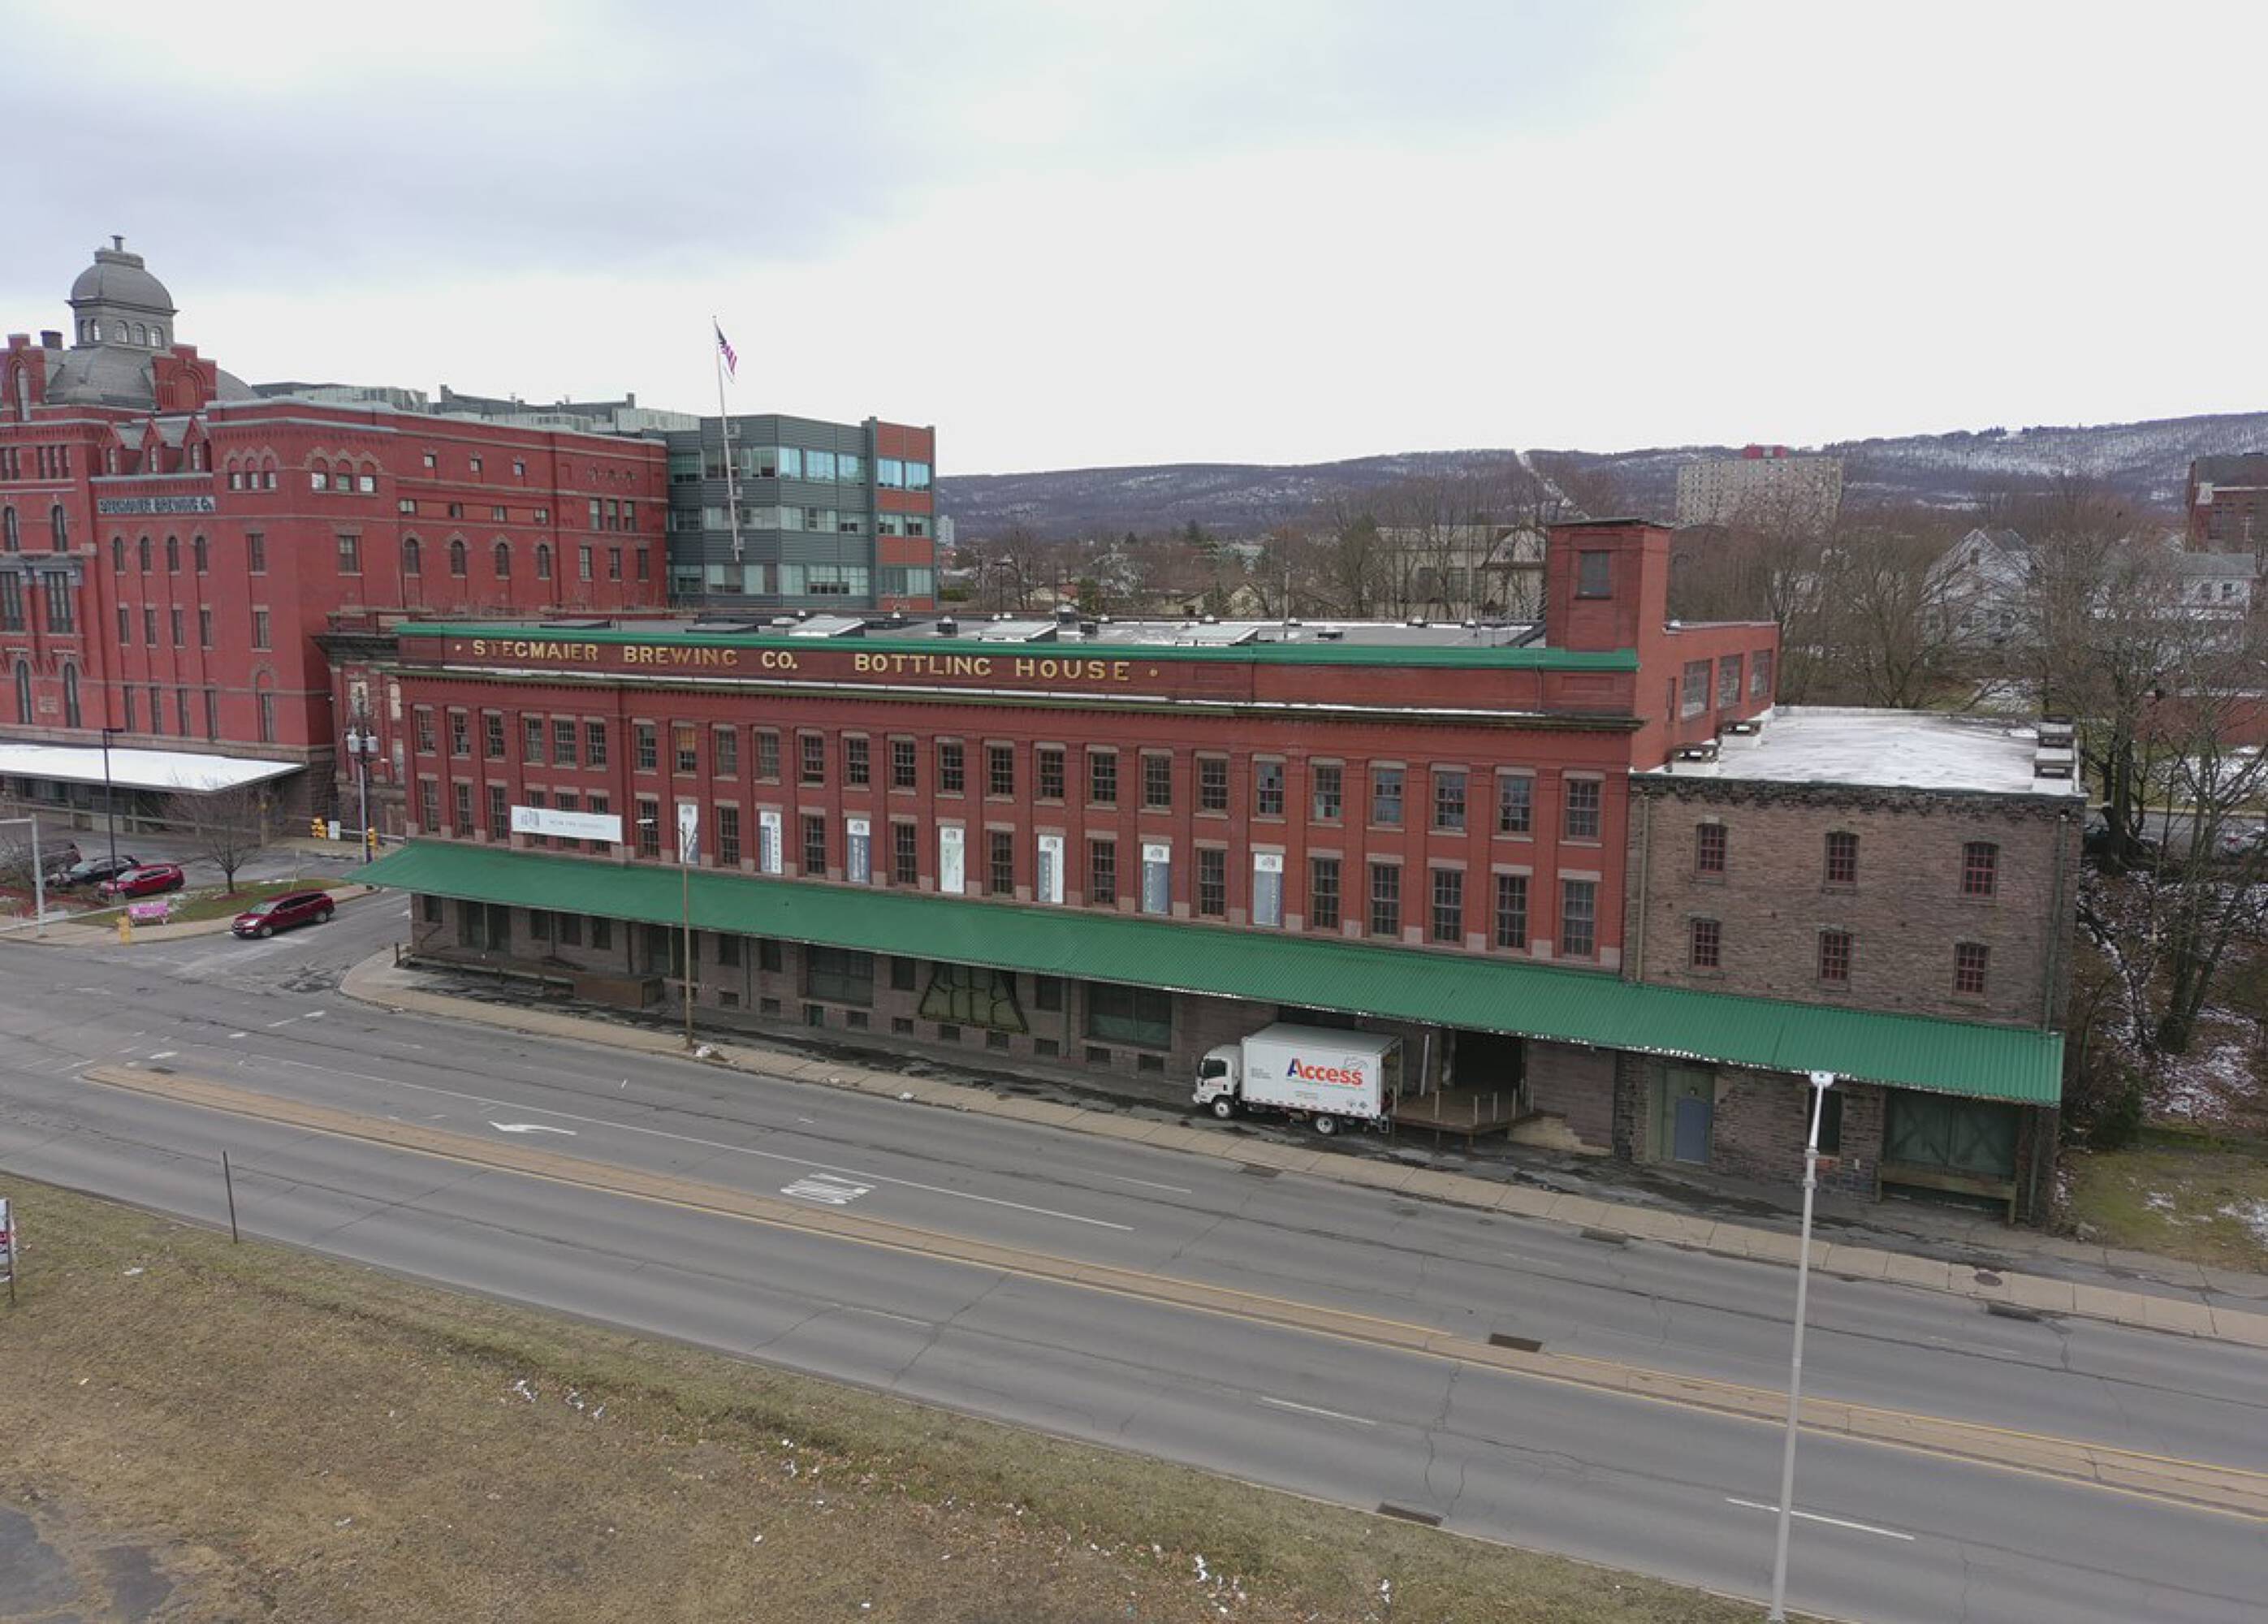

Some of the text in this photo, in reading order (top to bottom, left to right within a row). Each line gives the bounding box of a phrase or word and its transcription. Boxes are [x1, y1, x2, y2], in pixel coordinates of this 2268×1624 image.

[473, 639, 1131, 681] STEGMAIER BREWING CO. BOTTLING HOUSE
[1286, 1058, 1363, 1086] Access
